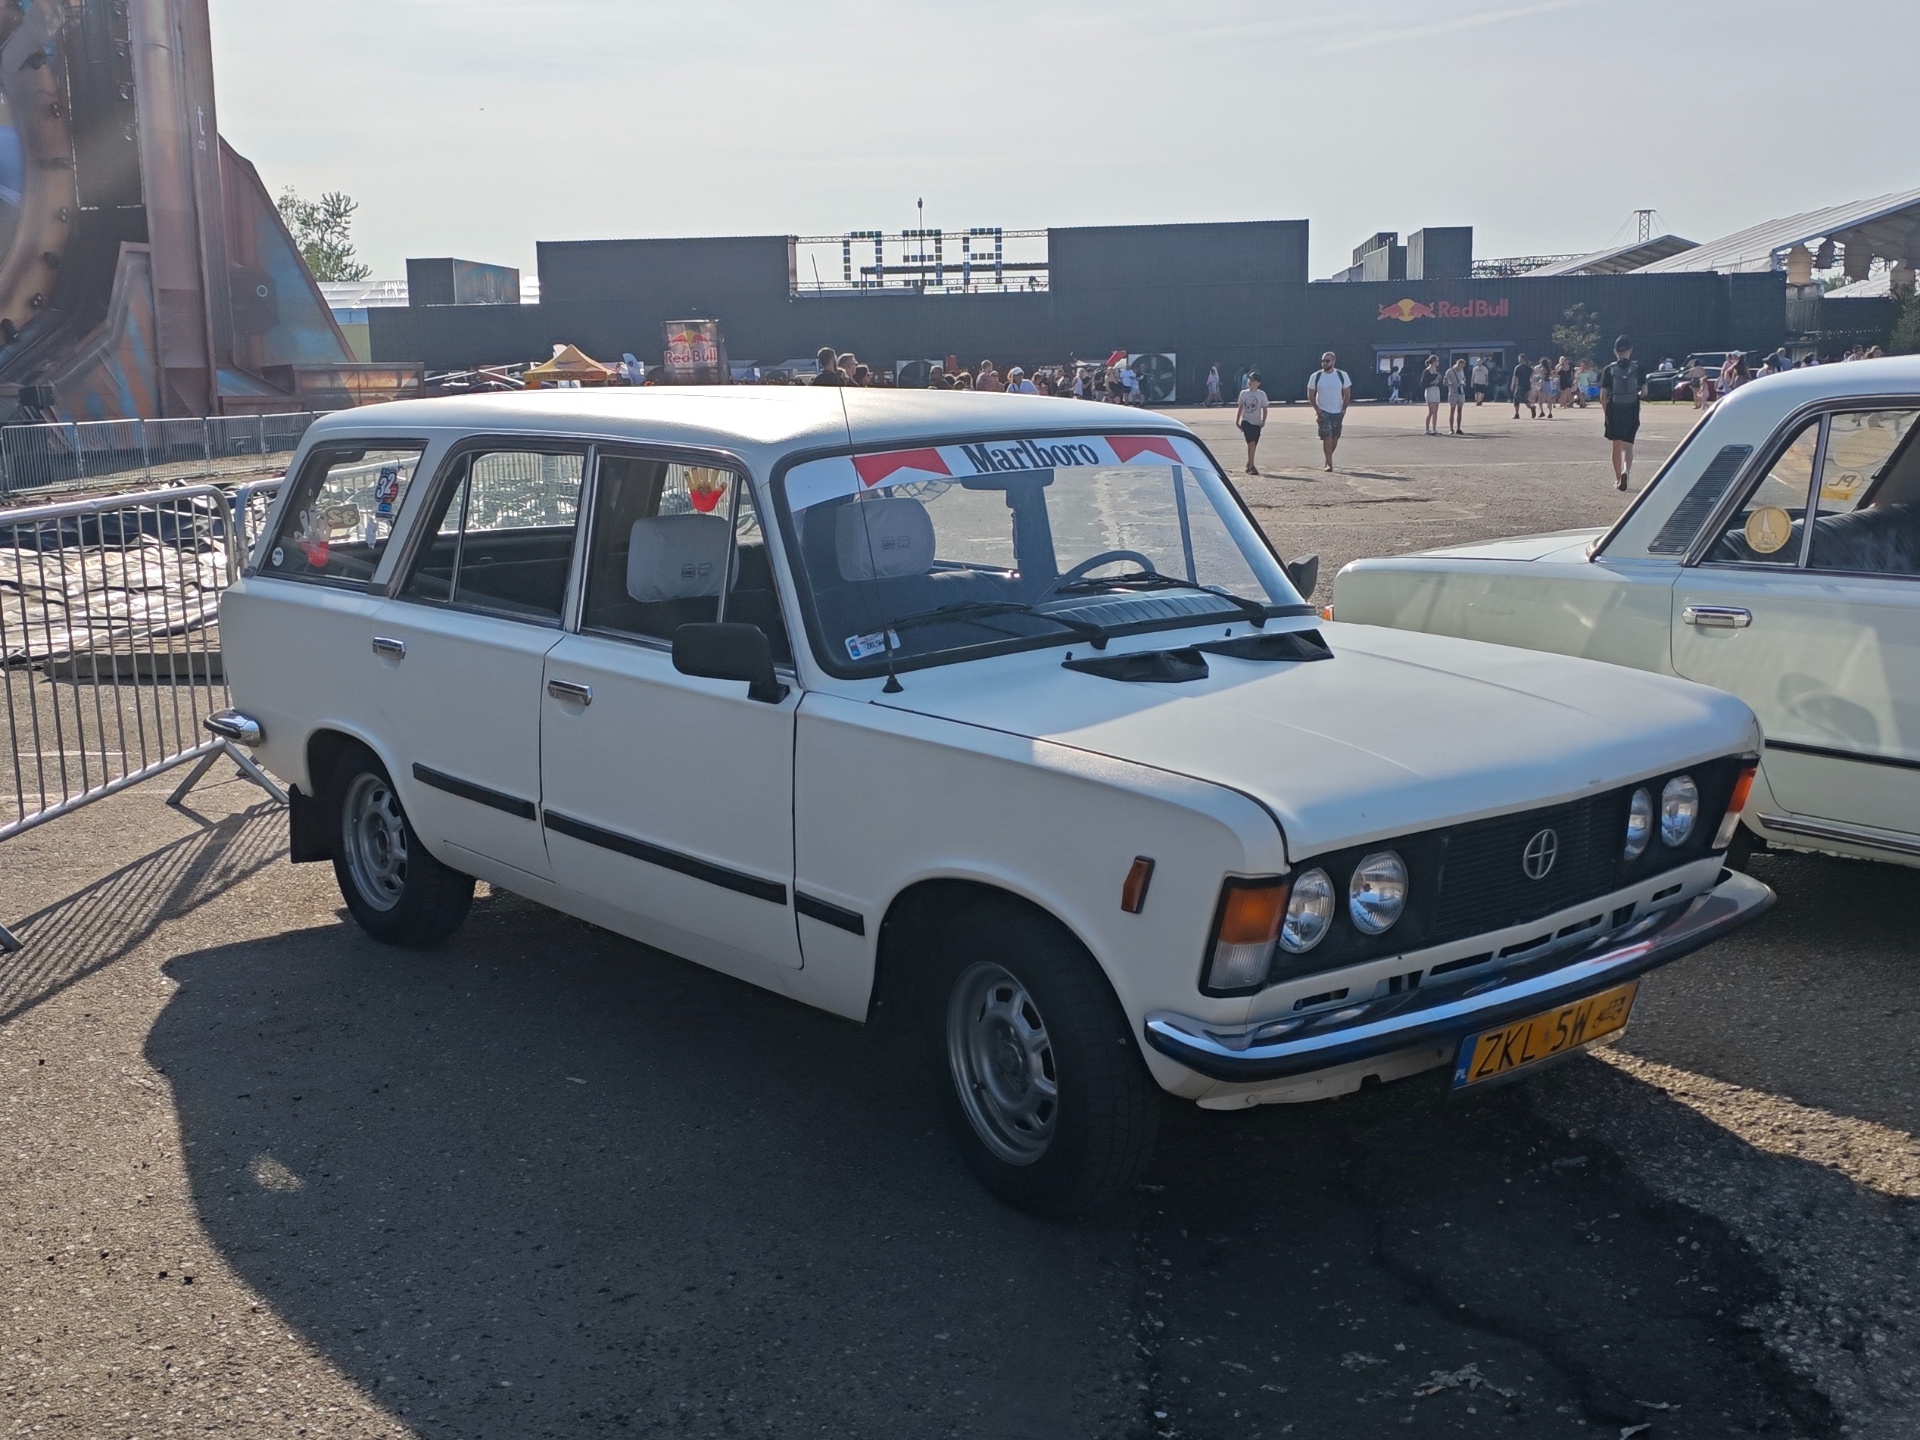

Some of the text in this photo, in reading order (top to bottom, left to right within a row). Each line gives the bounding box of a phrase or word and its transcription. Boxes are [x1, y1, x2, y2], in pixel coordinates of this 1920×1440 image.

[1438, 298, 1509, 318] Red Bull
[664, 348, 718, 365] Red Bull
[959, 440, 1100, 474] Marlboro
[375, 472, 396, 499] 32
[1475, 1002, 1595, 1078] ZKL 5W
[1454, 1069, 1467, 1081] PL
